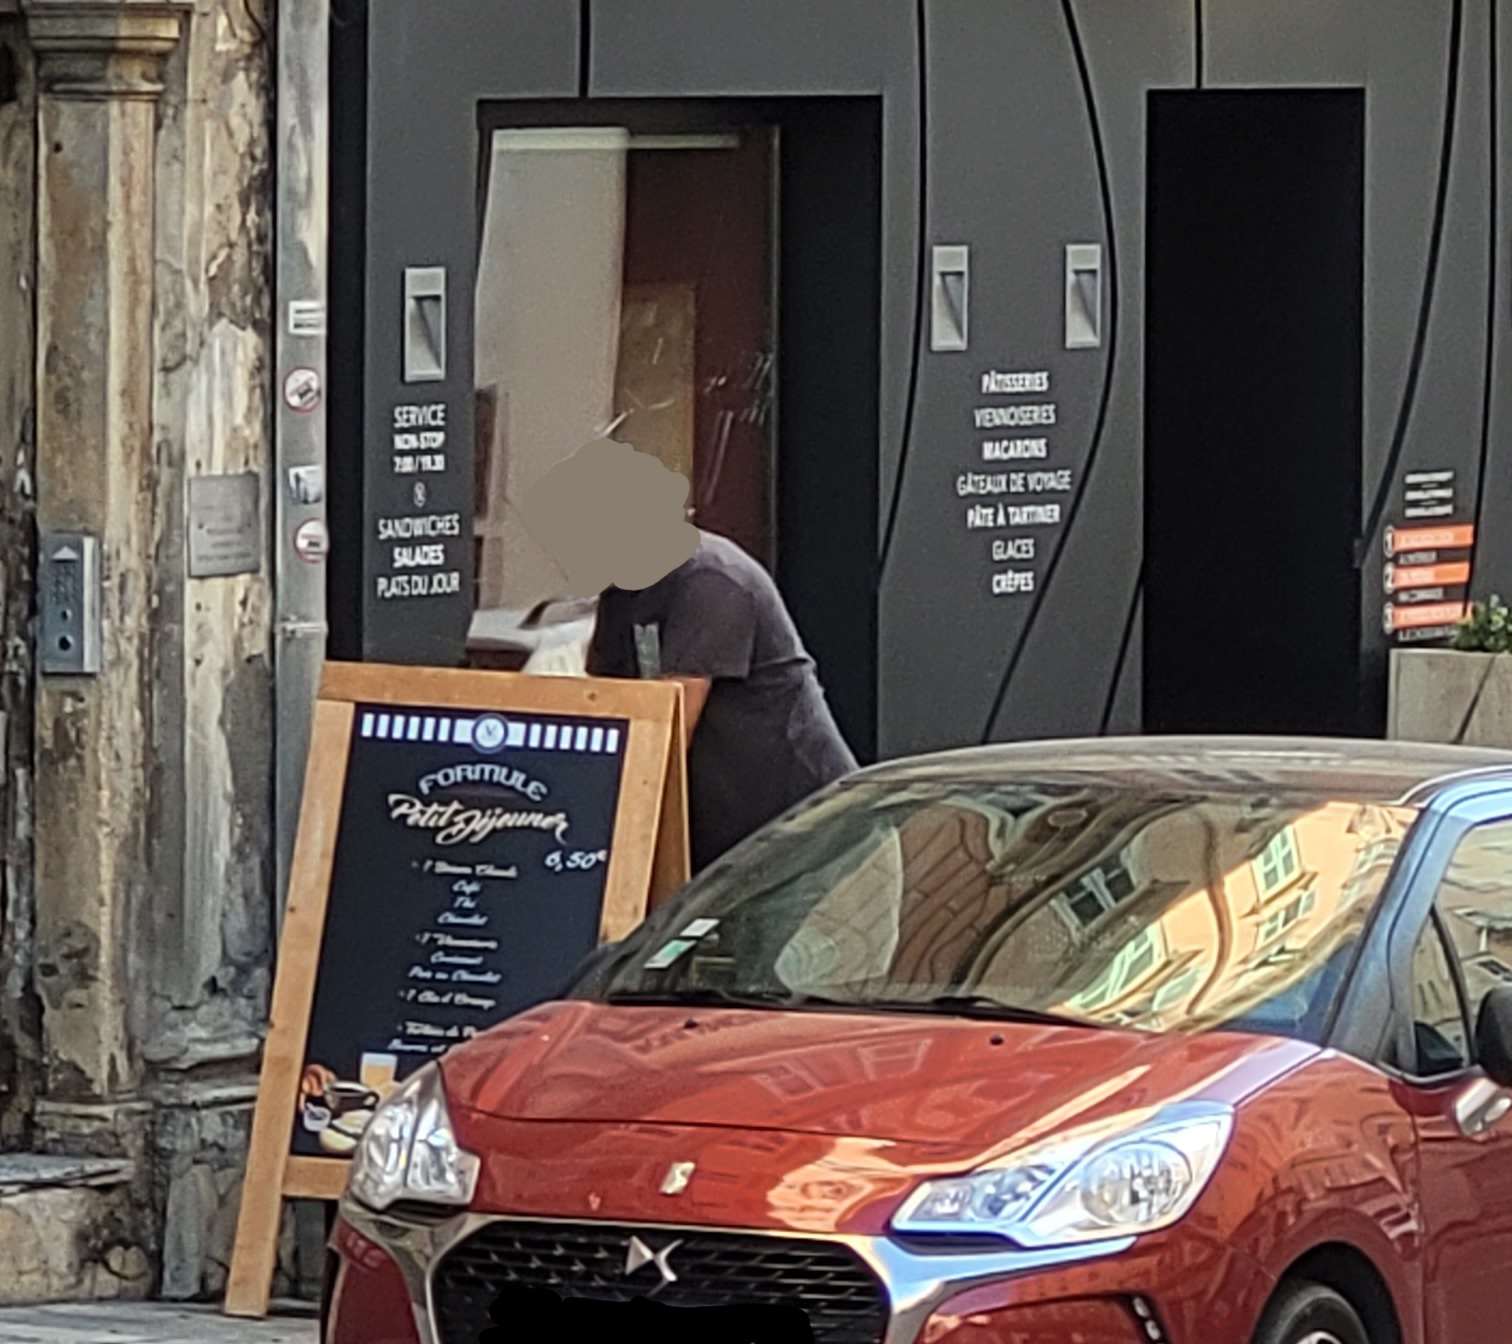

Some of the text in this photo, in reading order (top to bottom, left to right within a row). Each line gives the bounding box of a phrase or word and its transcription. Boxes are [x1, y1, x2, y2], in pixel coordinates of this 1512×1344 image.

[981, 370, 1048, 393] PÂTISSERIES
[393, 404, 445, 427] SERVICE
[973, 404, 1055, 427] VIENNOISERIES
[982, 438, 1047, 460] MACARONS
[956, 470, 1072, 496] GÂTEAUX DE VOYAGE
[378, 514, 460, 540] SANDWICHES
[966, 503, 1060, 528] PÂTE À TARTINER
[393, 544, 444, 567] SALADES
[992, 539, 1035, 560] GLACES
[376, 571, 460, 598] PLATS DU JOUR
[992, 570, 1034, 594] CRÊPES
[418, 762, 548, 802] FORMULE
[387, 793, 464, 829] Petit
